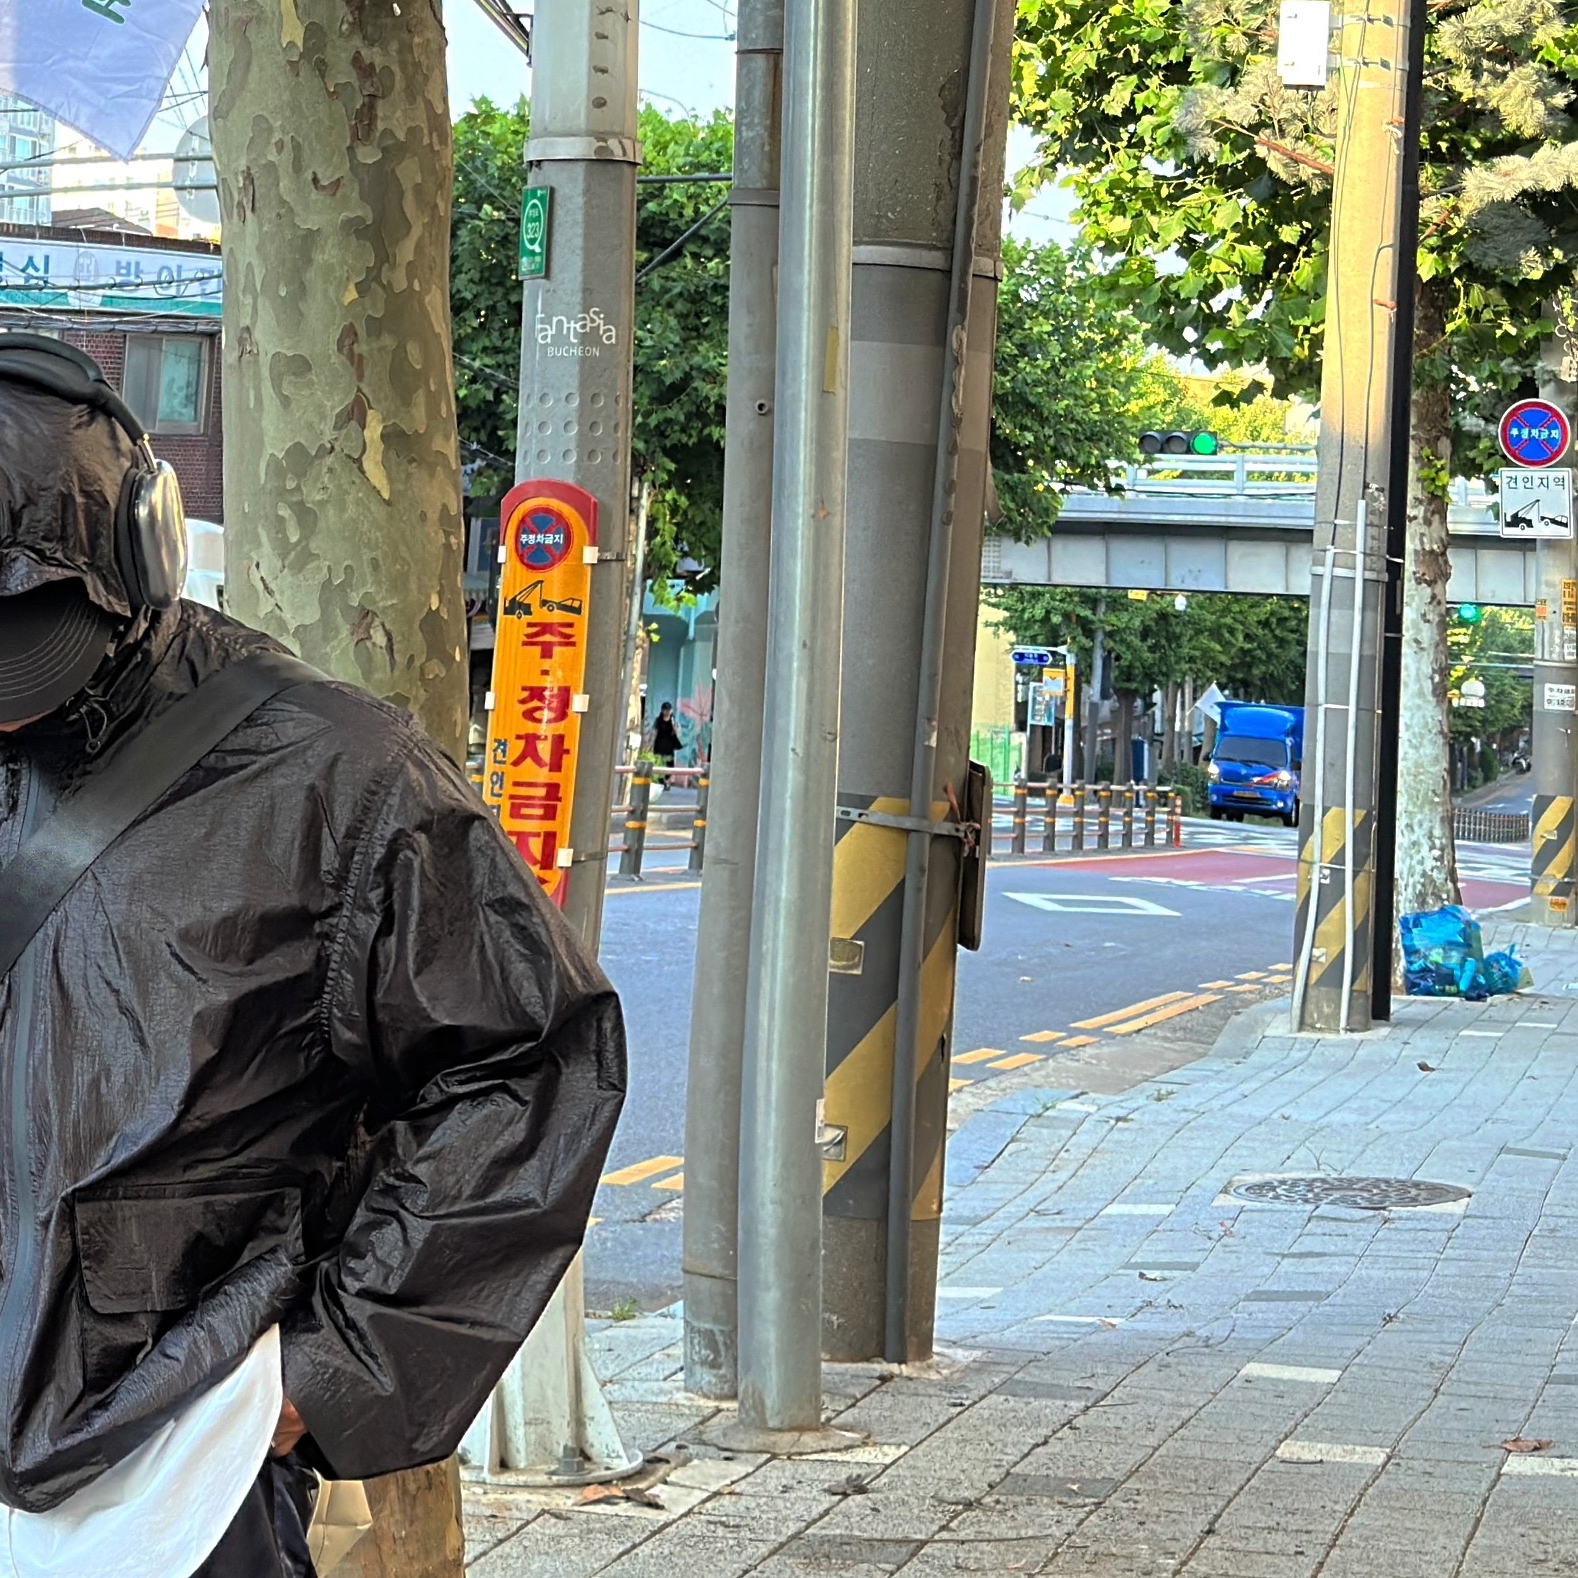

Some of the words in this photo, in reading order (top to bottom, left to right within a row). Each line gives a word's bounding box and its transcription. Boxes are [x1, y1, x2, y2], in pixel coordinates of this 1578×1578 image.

[547, 345, 600, 357] BUCHEON
[1510, 427, 1559, 440] 주정차금지
[1505, 475, 1566, 491] 견인지역
[520, 533, 564, 544] 주정차금지
